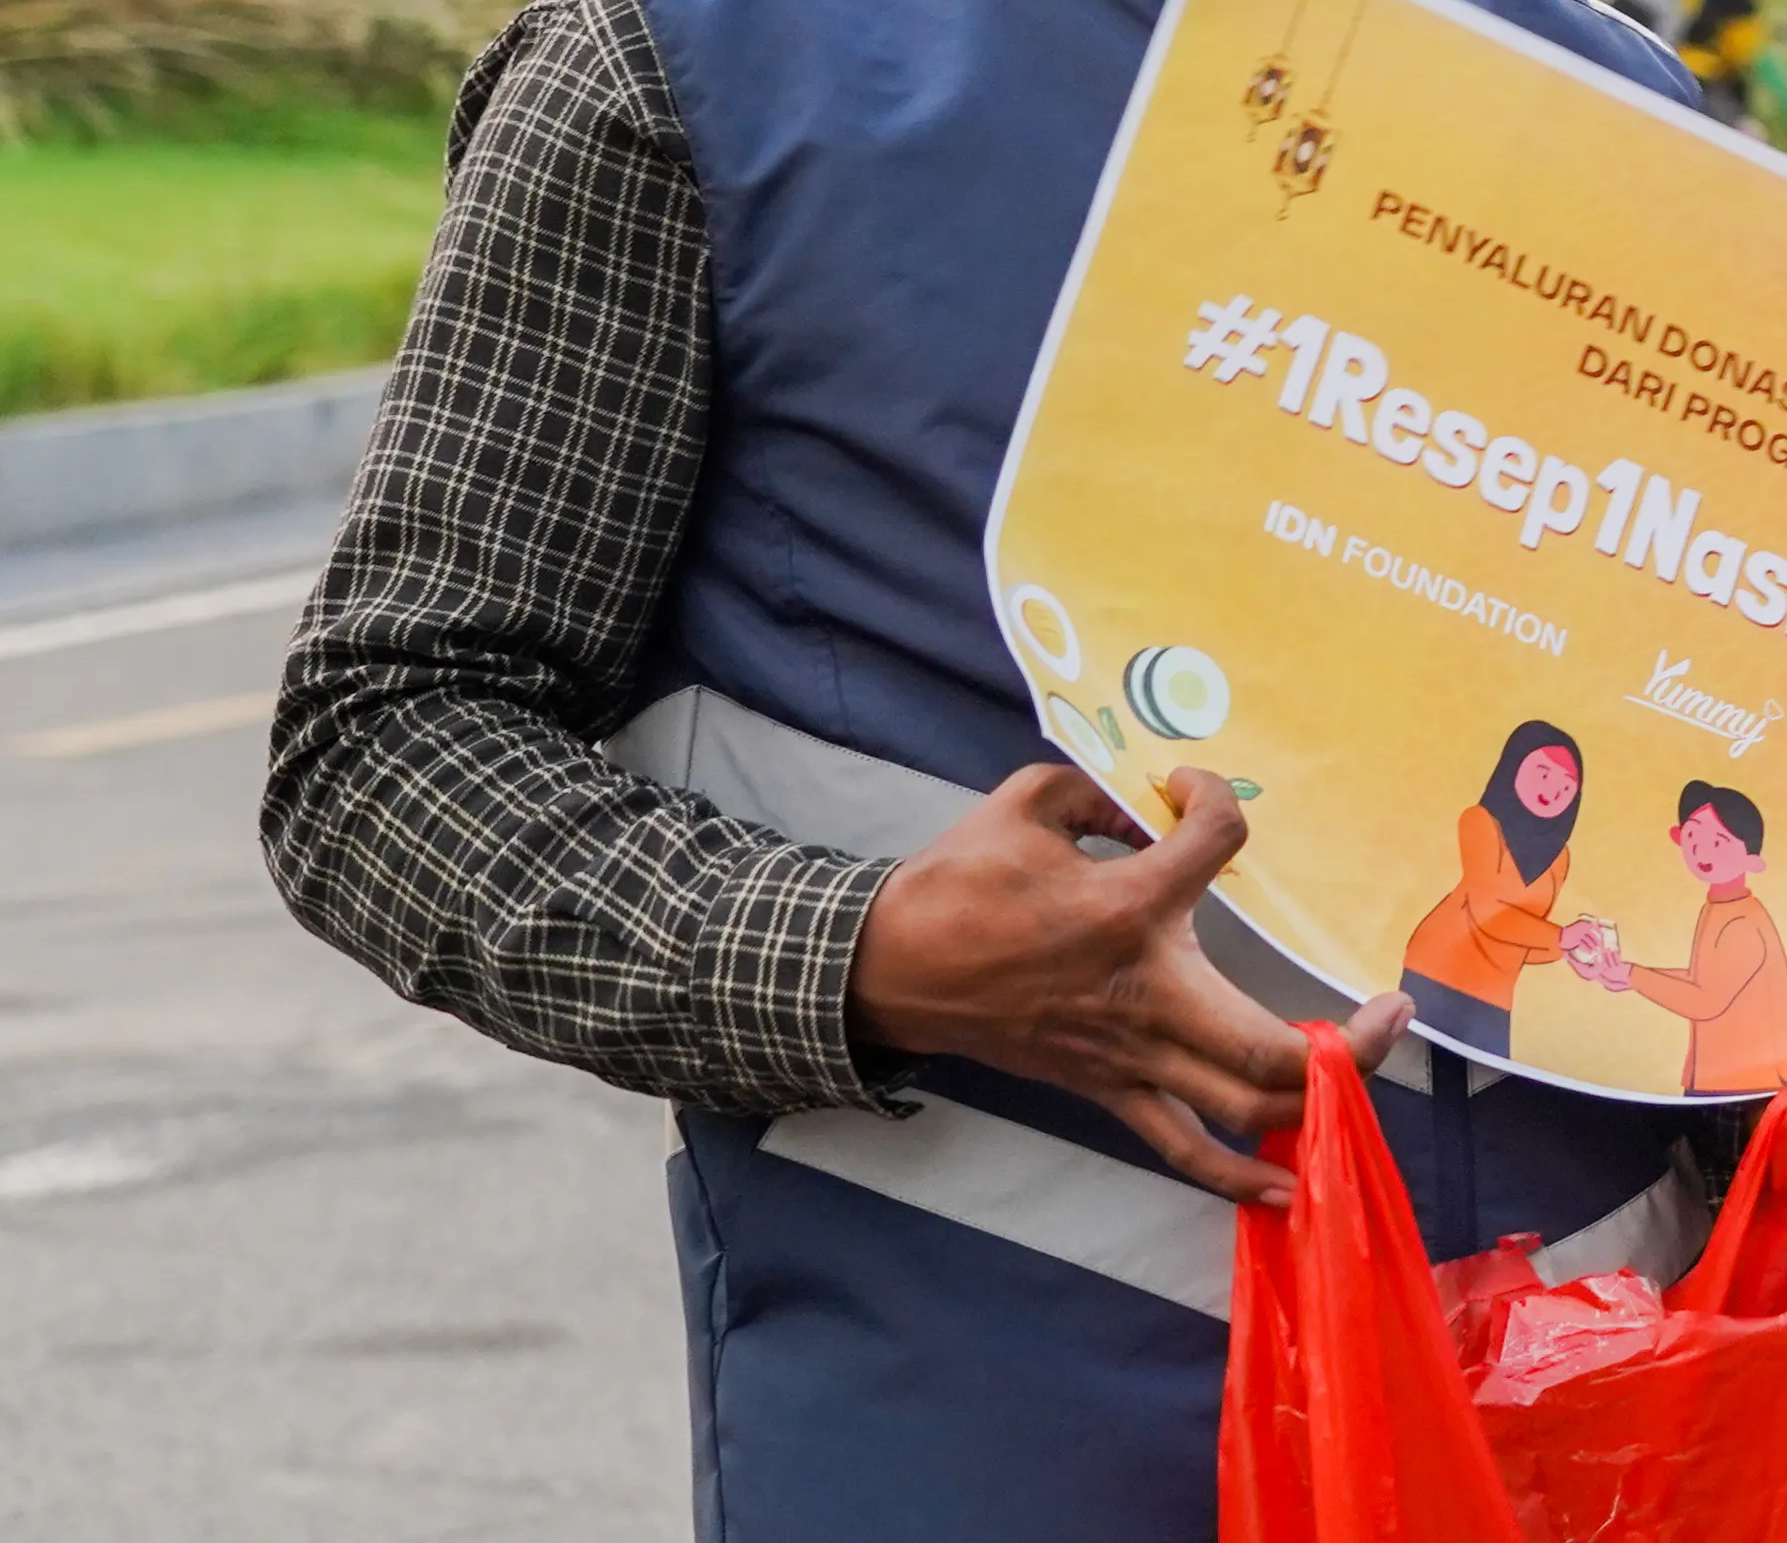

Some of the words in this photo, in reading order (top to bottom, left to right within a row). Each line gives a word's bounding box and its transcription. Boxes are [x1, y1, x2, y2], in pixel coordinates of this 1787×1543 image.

[1370, 188, 1657, 344] PENYALURAN
[1575, 343, 1674, 413] DARI
[1263, 499, 1337, 559] IDN
[1340, 534, 1570, 658] FOUNDATION
[1630, 648, 1769, 759] Yummy
